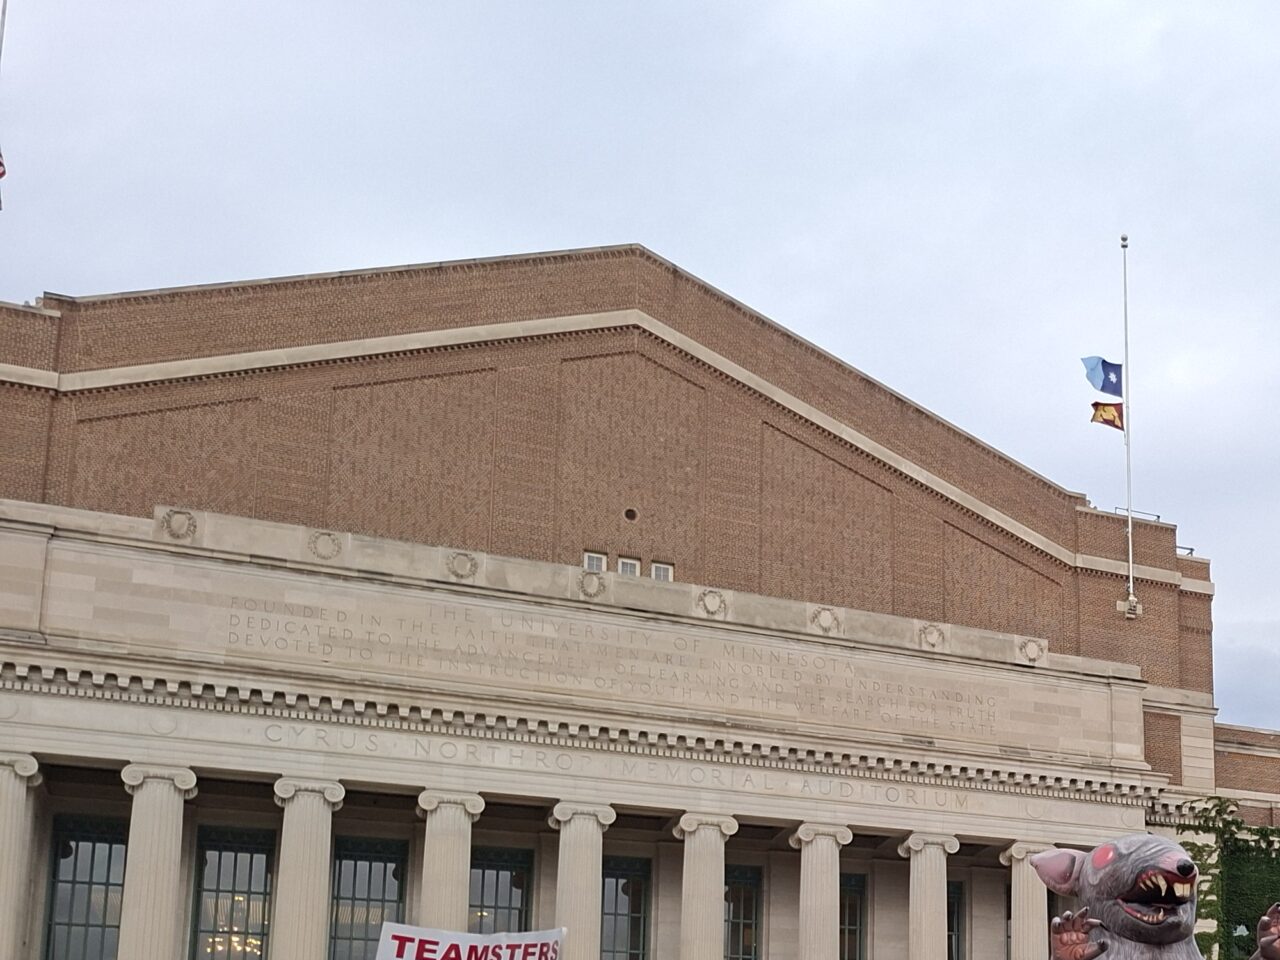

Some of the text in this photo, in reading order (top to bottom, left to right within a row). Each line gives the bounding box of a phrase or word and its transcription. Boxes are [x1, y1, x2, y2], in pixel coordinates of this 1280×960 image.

[228, 631, 997, 736] DEVOTED TO THE INSTRUCTION OF YOUTH AND THE WELFARE OF THE STATE
[229, 614, 997, 722] DEDICATED TO THE ADVANCEMENT OF LEARNING AND THE SEARCH FOR TRUTH
[230, 597, 997, 707] FOUNDED IN THE FAITH THAT MEN ARE ENNOBLED BY UNDERSTANDING
[429, 604, 854, 674] THE UNIVERSITY OF MINNESOTA
[264, 723, 970, 810] CYRUS NORTHROP MEMORIAL AUDITORIUM
